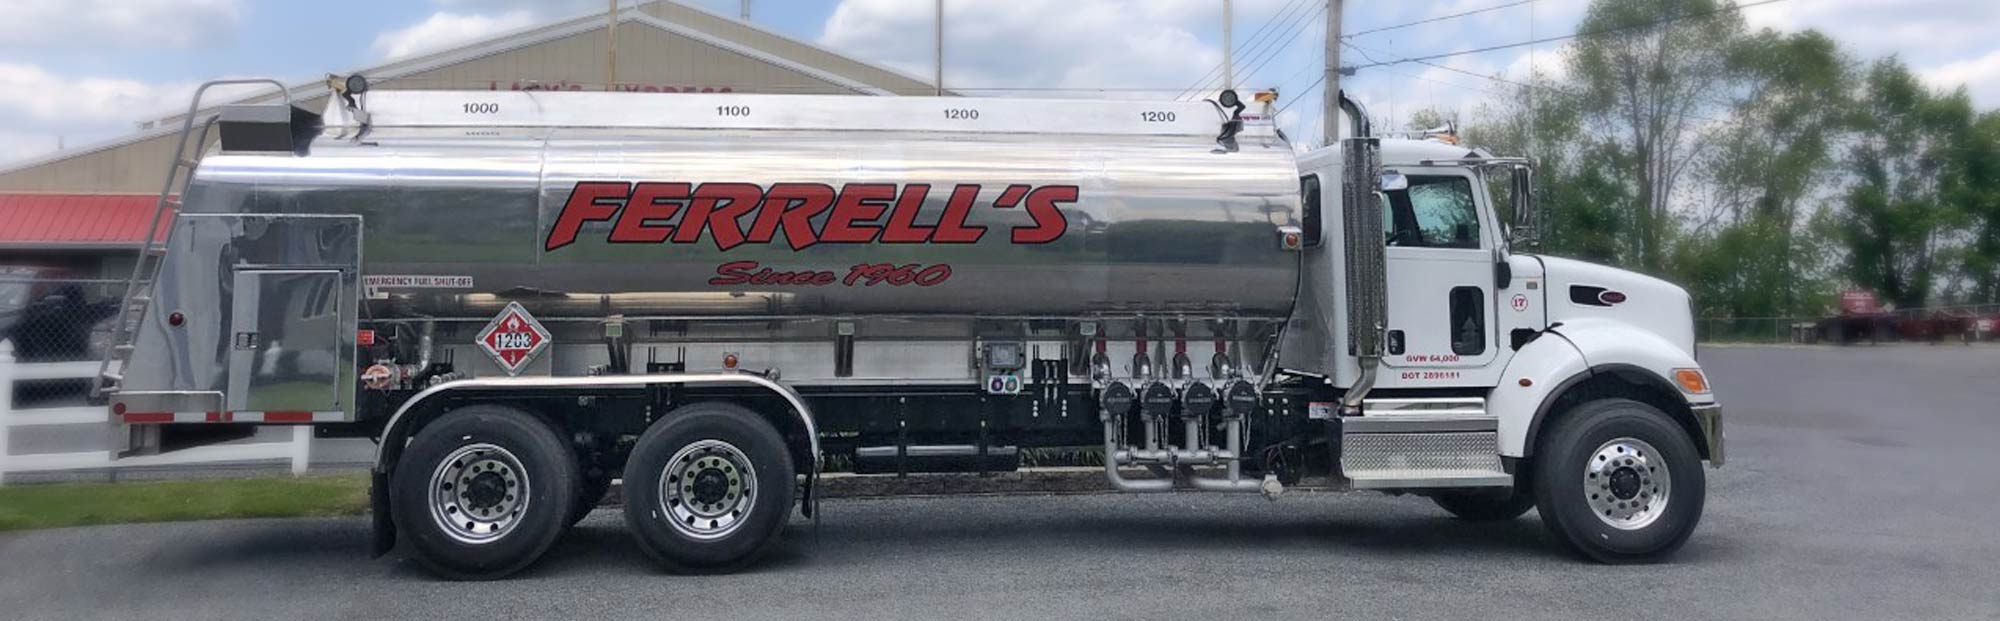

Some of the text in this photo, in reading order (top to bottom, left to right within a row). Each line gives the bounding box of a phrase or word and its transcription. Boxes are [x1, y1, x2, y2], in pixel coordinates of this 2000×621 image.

[463, 102, 499, 114] 1000
[717, 105, 751, 117] 1100
[943, 108, 980, 121] 1200
[1140, 110, 1177, 123] 1200
[545, 181, 1080, 252] FERRELL'S
[708, 260, 952, 287] Since 1960
[1513, 298, 1525, 307] 17
[497, 332, 532, 349] 1203
[1406, 354, 1428, 362] GVW
[1401, 371, 1420, 379] DOT
